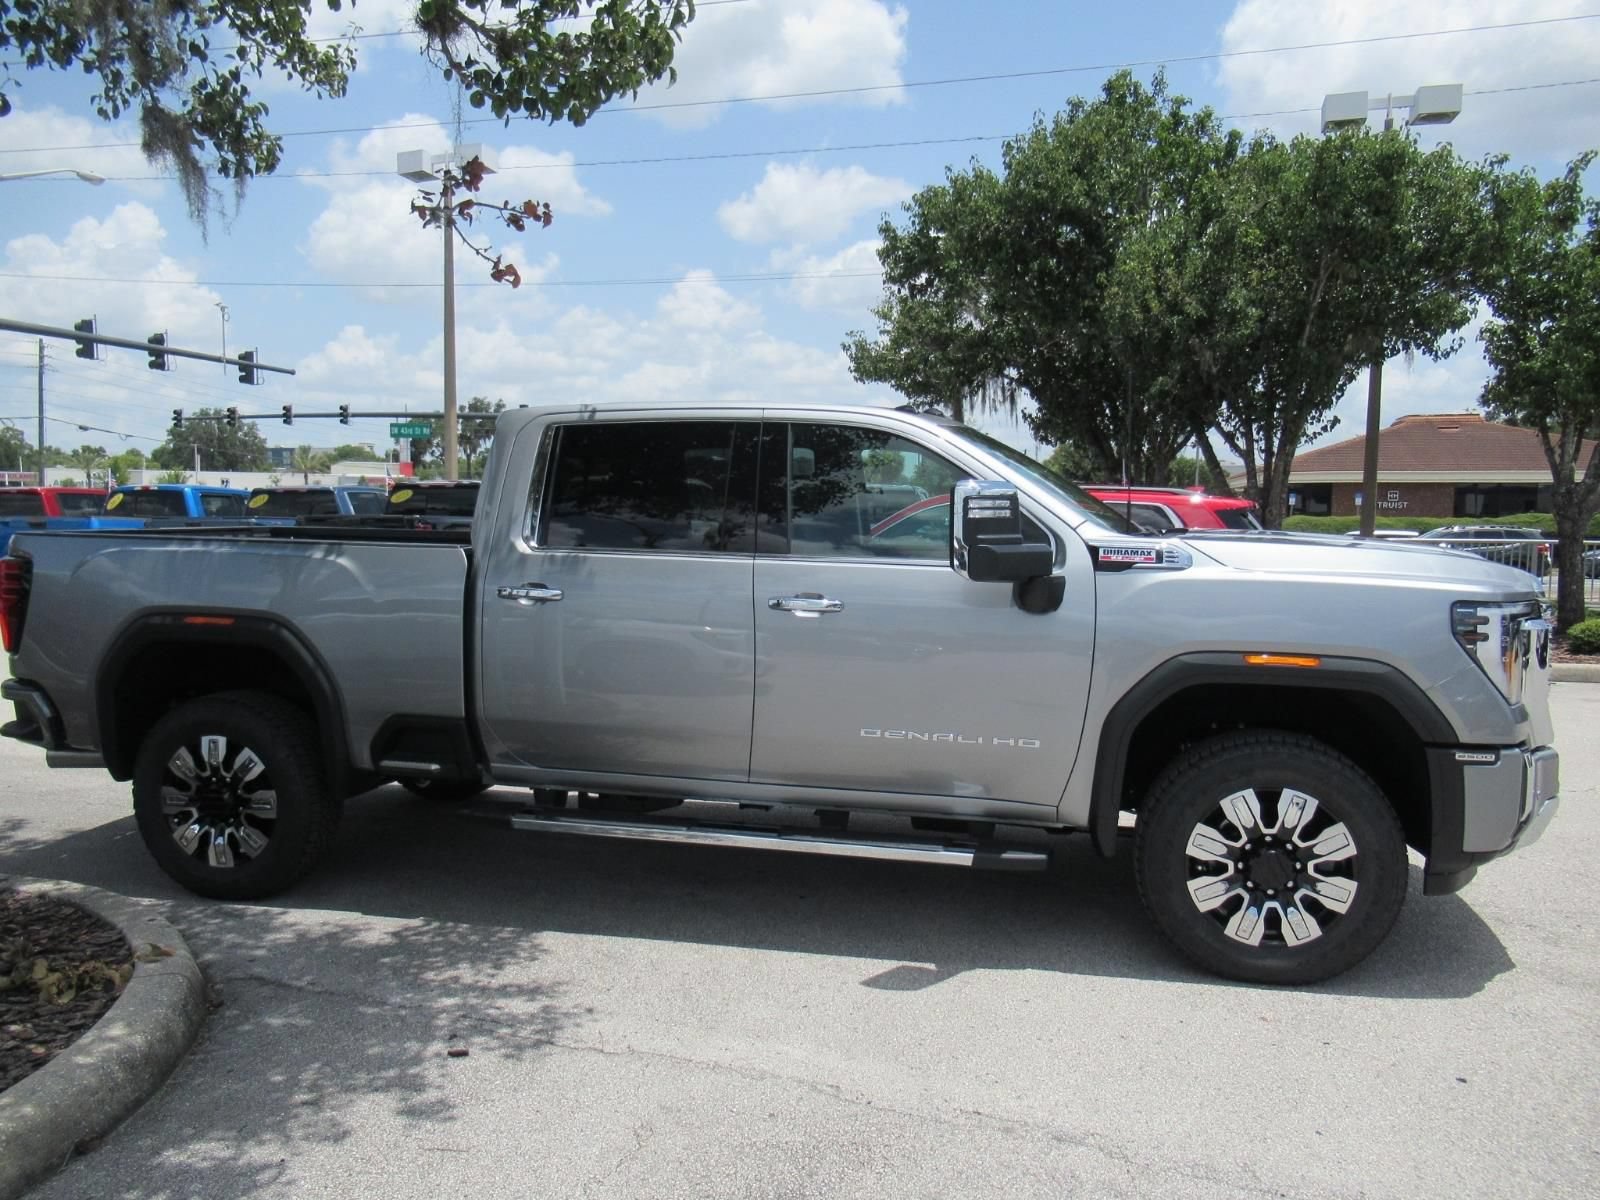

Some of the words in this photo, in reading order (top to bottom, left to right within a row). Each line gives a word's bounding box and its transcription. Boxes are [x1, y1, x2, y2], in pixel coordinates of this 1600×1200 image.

[400, 426, 413, 435] 43rd
[415, 427, 421, 435] St
[1376, 501, 1409, 509] TRUIST
[1102, 548, 1153, 557] DURAMAX
[860, 728, 983, 744] DENALI
[992, 737, 1041, 748] HD
